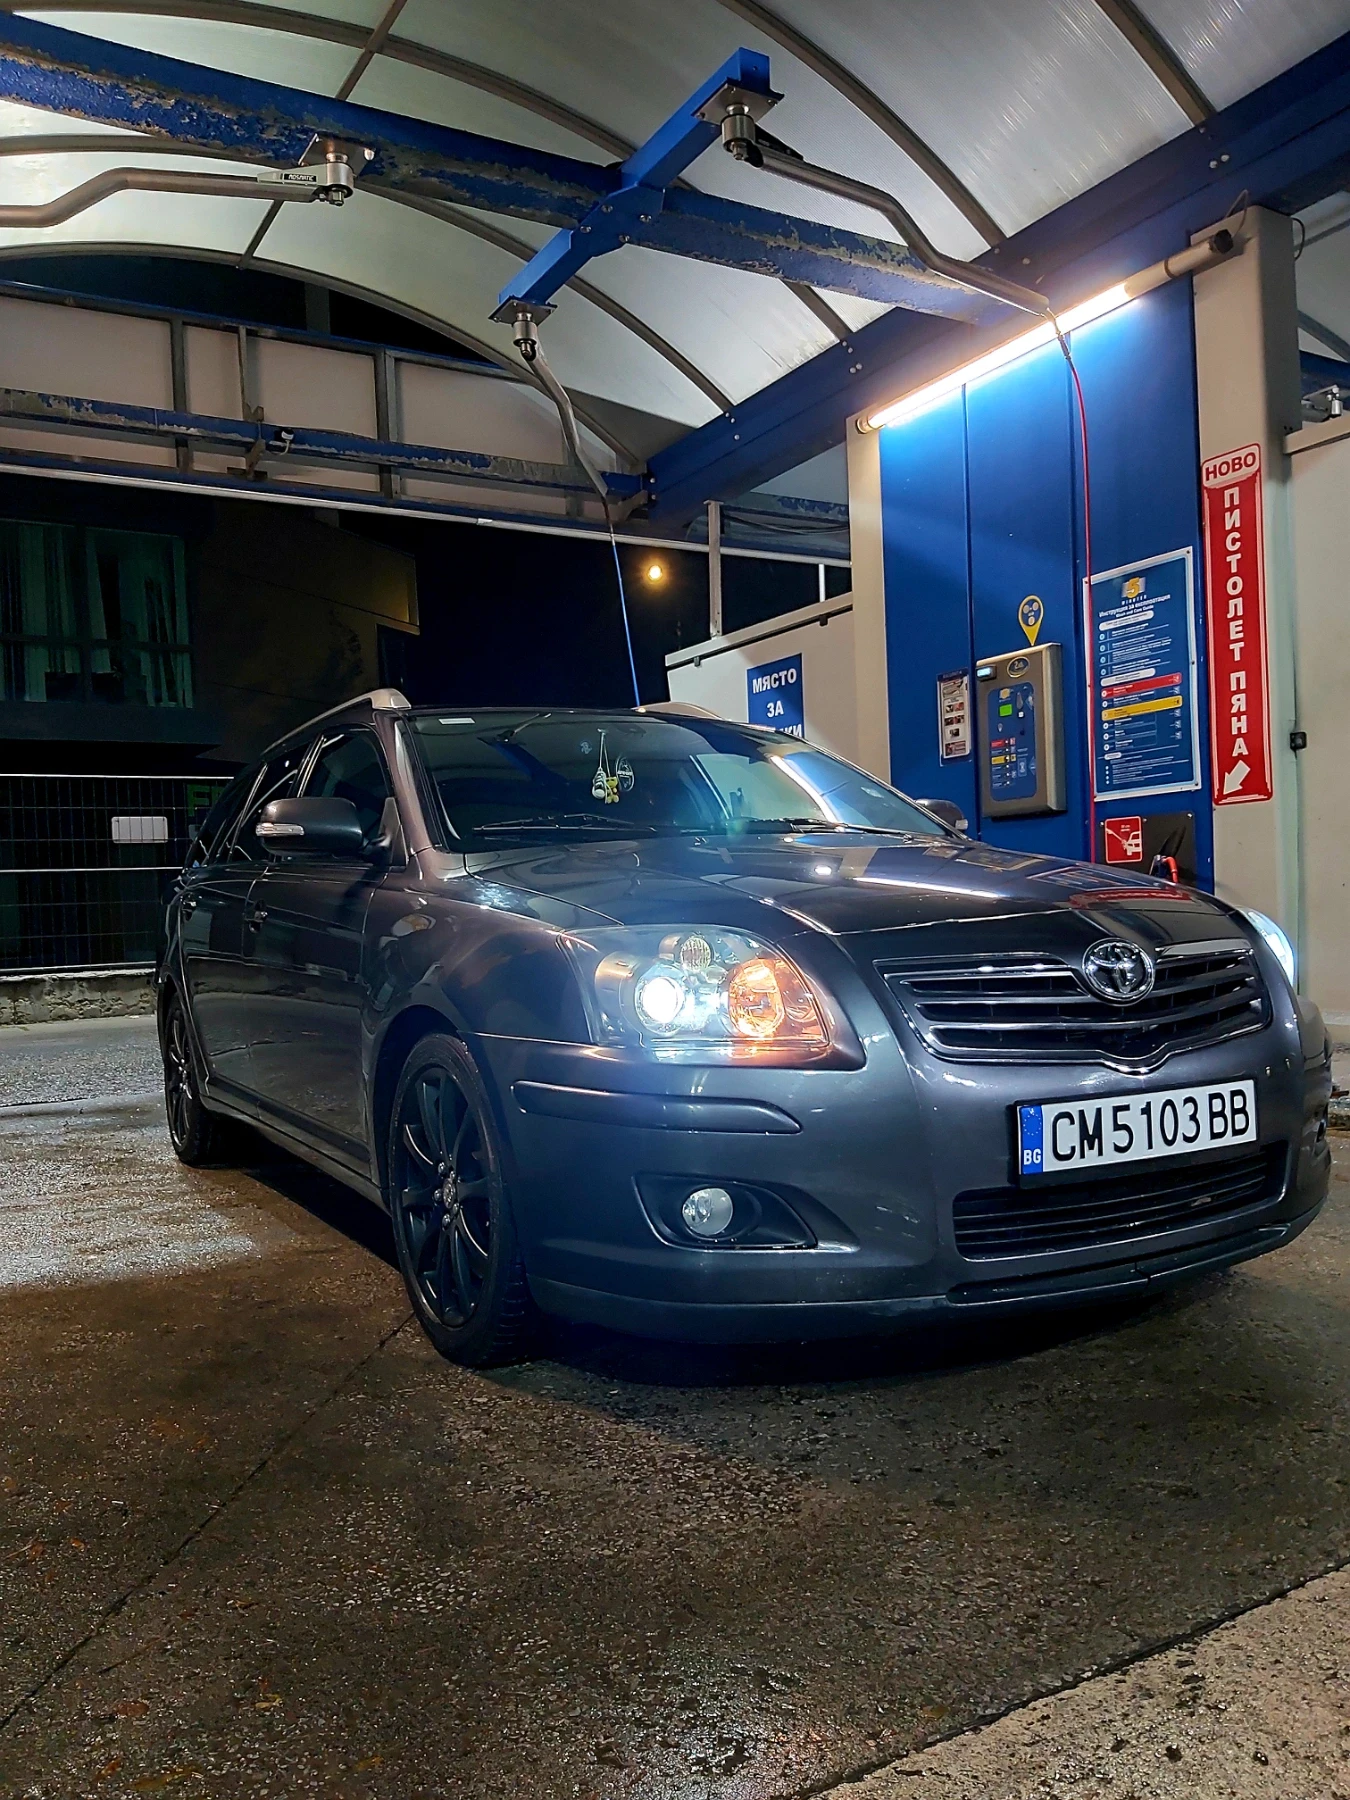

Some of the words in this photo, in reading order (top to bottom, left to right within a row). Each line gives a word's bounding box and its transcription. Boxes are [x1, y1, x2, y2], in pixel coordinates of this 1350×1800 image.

[1205, 452, 1256, 482] НОВО
[1224, 488, 1246, 662] ПИСТОЛЕТ
[752, 668, 797, 694] МЯСТО
[766, 700, 784, 718] ЗА
[1229, 672, 1250, 757] ПЯНА
[1023, 1149, 1042, 1165] BG
